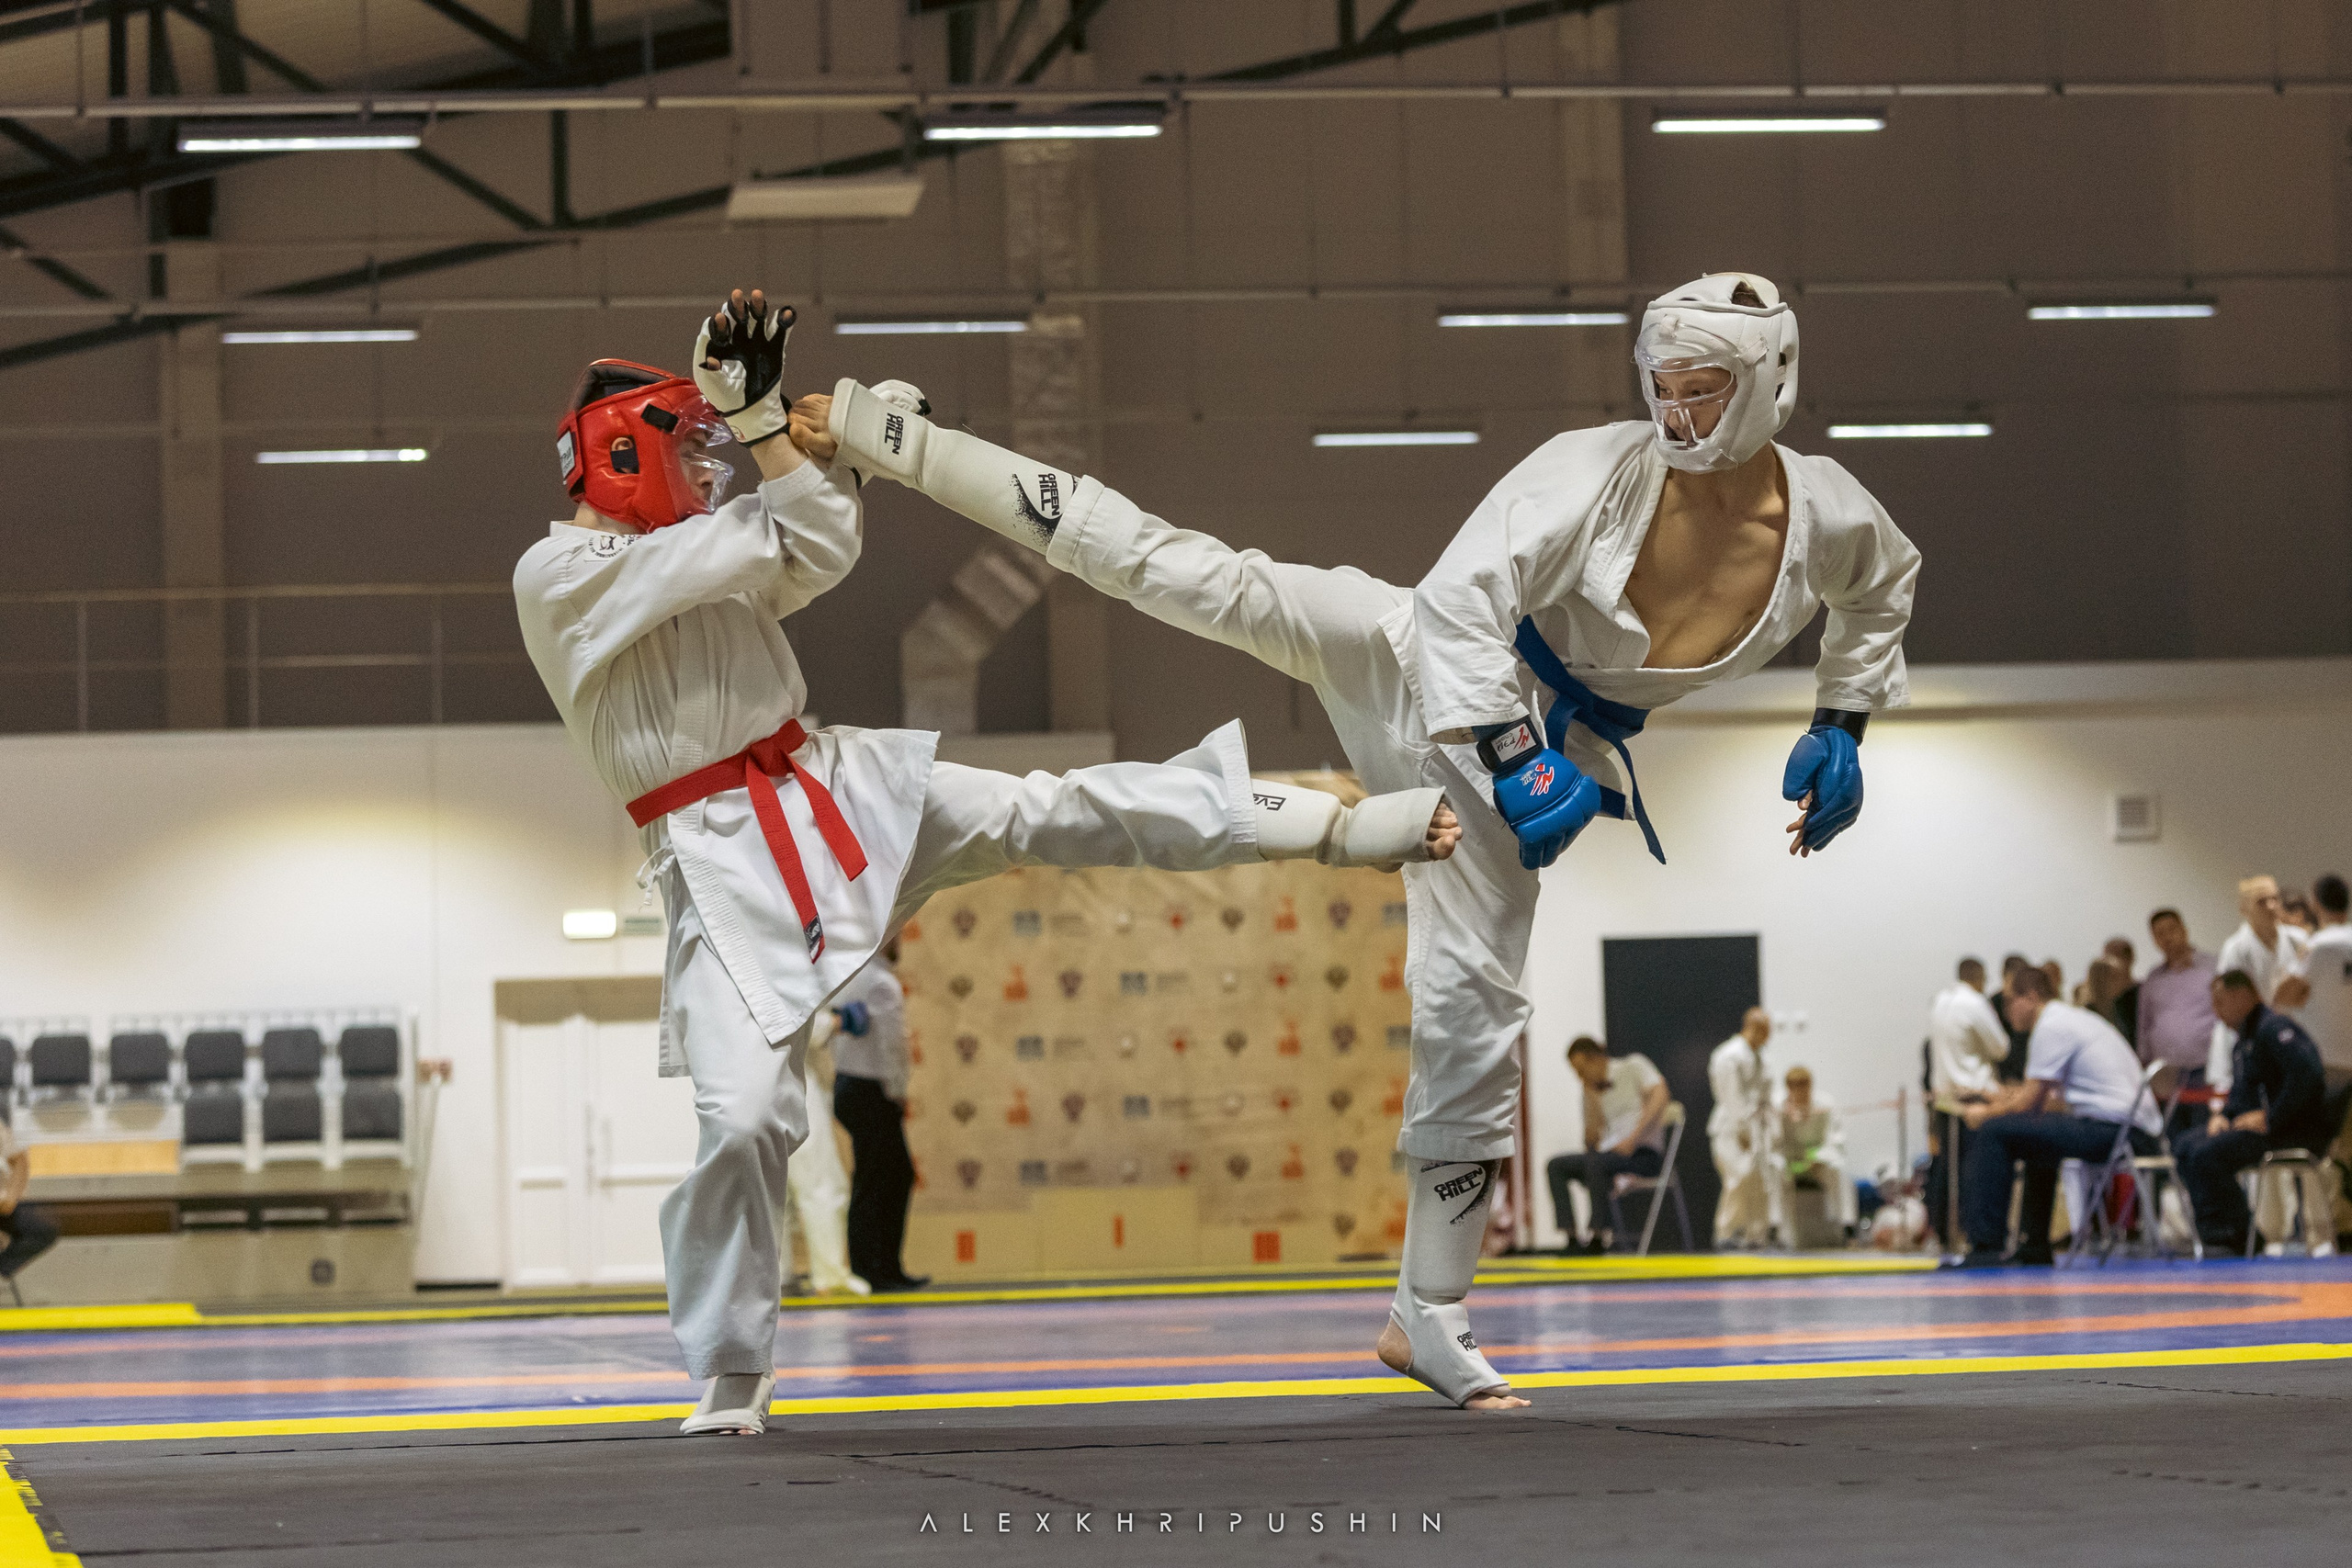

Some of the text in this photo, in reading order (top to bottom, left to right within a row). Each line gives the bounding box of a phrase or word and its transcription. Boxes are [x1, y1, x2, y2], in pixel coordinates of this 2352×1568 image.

[885, 412, 897, 444] HILL
[892, 415, 904, 455] GREEN
[1038, 474, 1052, 511] HILL
[1047, 473, 1060, 516] GREEN
[1434, 1167, 1483, 1192] GREEN
[1439, 1179, 1481, 1201] HILL
[1456, 1330, 1474, 1342] GRE
[1461, 1338, 1477, 1351] HIL
